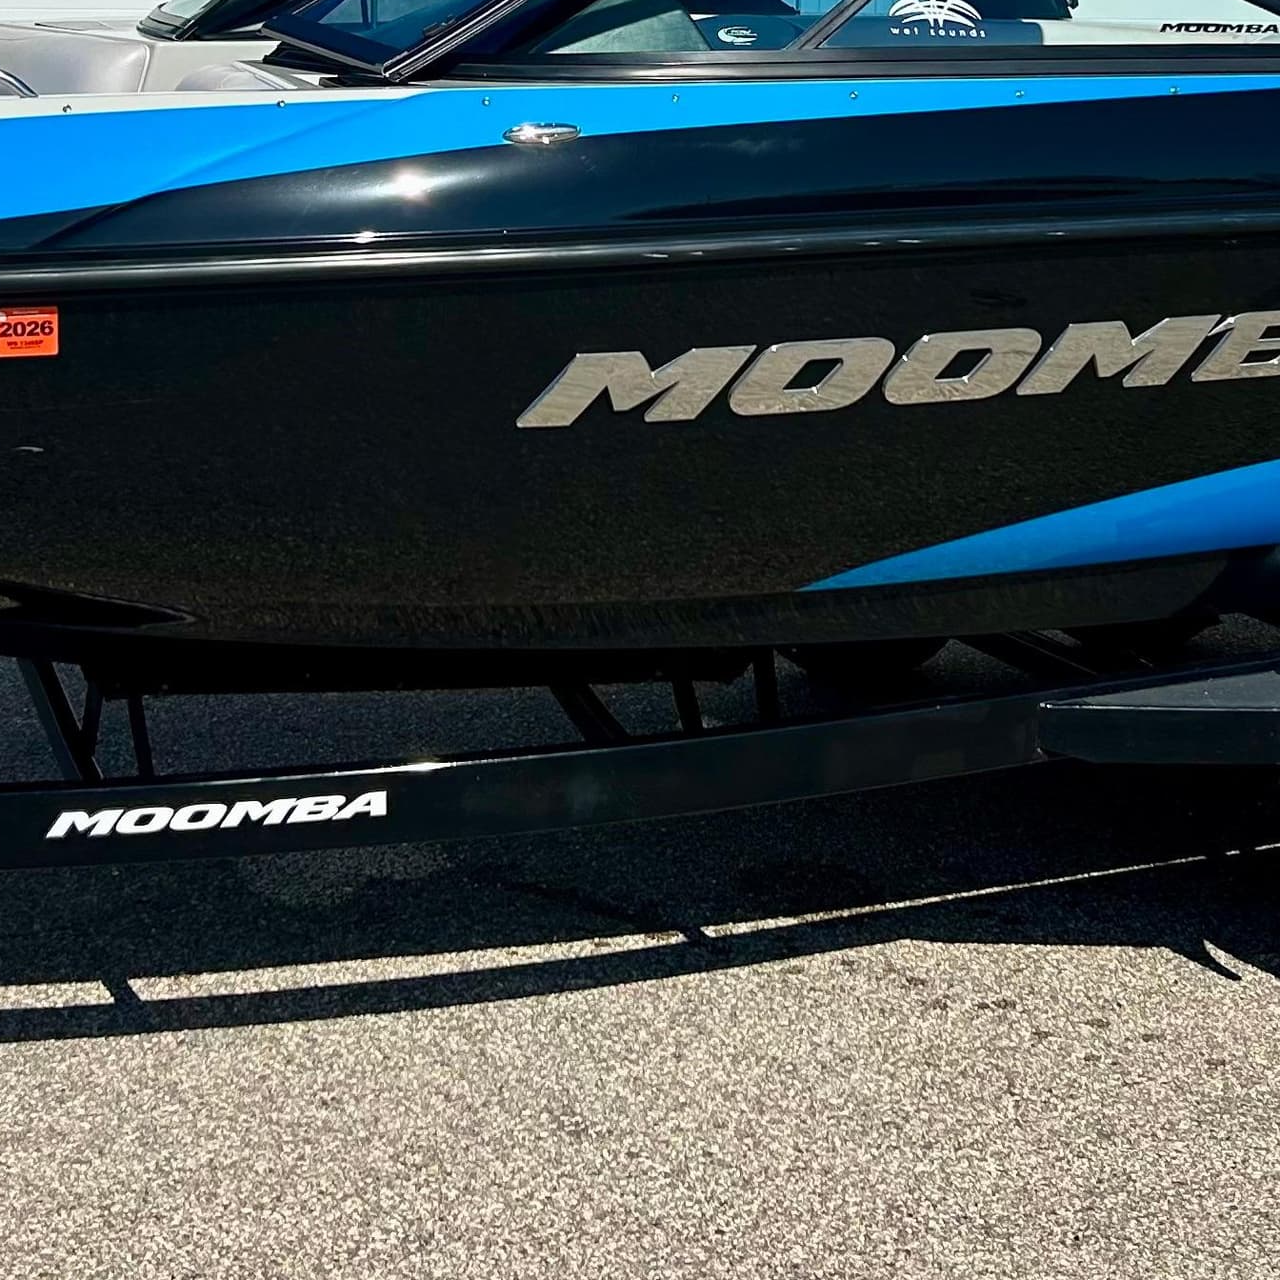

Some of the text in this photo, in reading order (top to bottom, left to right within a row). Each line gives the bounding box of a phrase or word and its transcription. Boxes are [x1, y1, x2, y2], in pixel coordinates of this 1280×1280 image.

[889, 26, 987, 39] wet sounds
[1159, 22, 1279, 34] MOOMBA
[44, 789, 388, 839] MOOMBA
